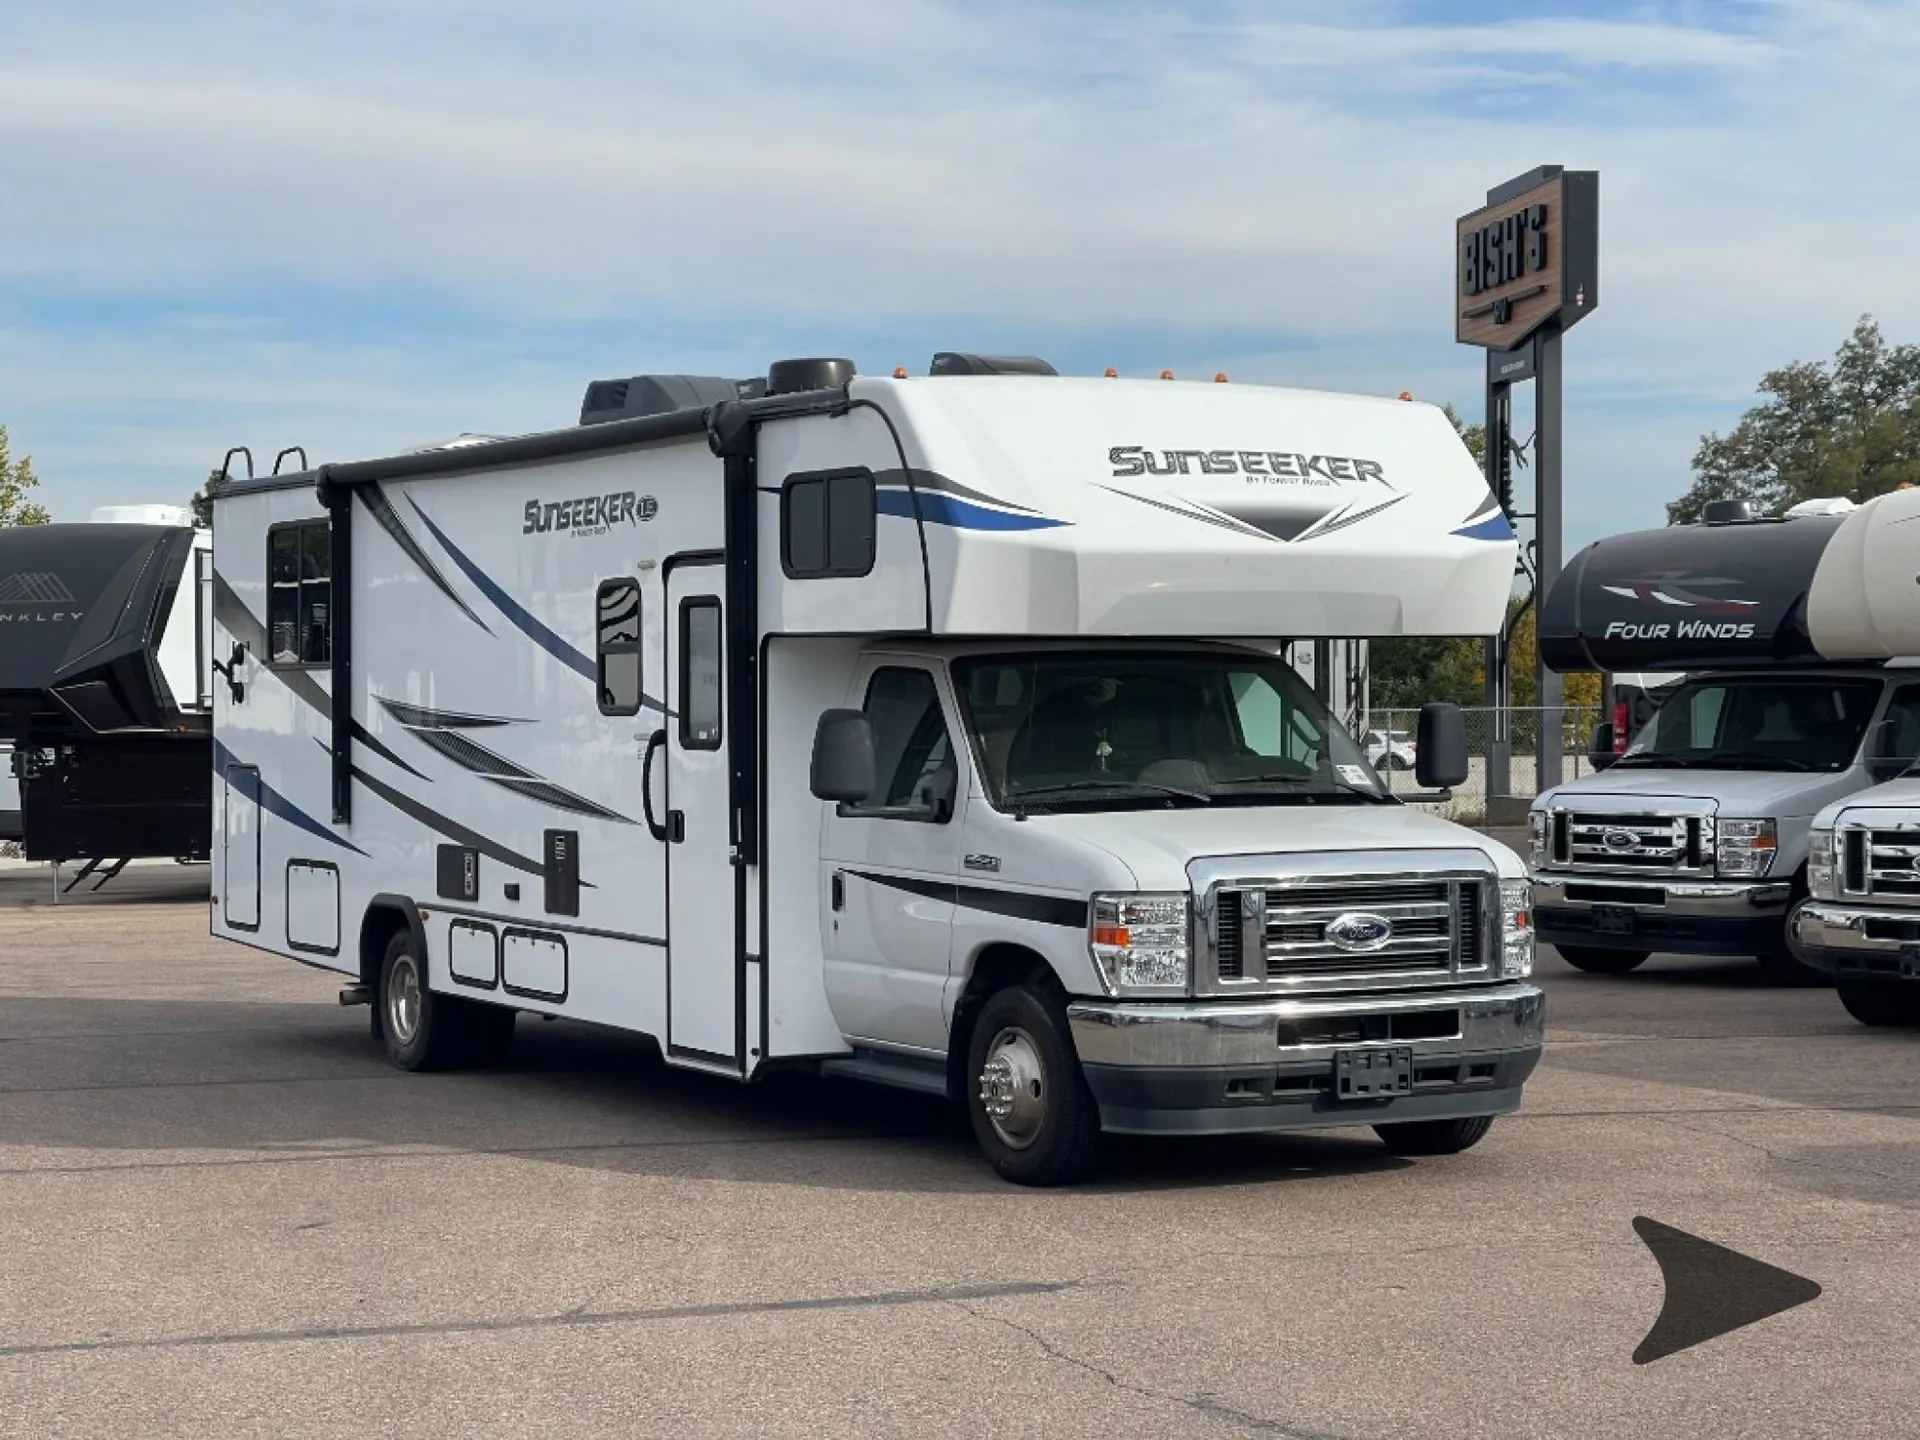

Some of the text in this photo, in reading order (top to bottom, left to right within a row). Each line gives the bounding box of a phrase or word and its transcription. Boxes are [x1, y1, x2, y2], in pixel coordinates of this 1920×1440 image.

[1462, 203, 1548, 296] BISH'S
[1604, 620, 1756, 639] FOUR WINDS
